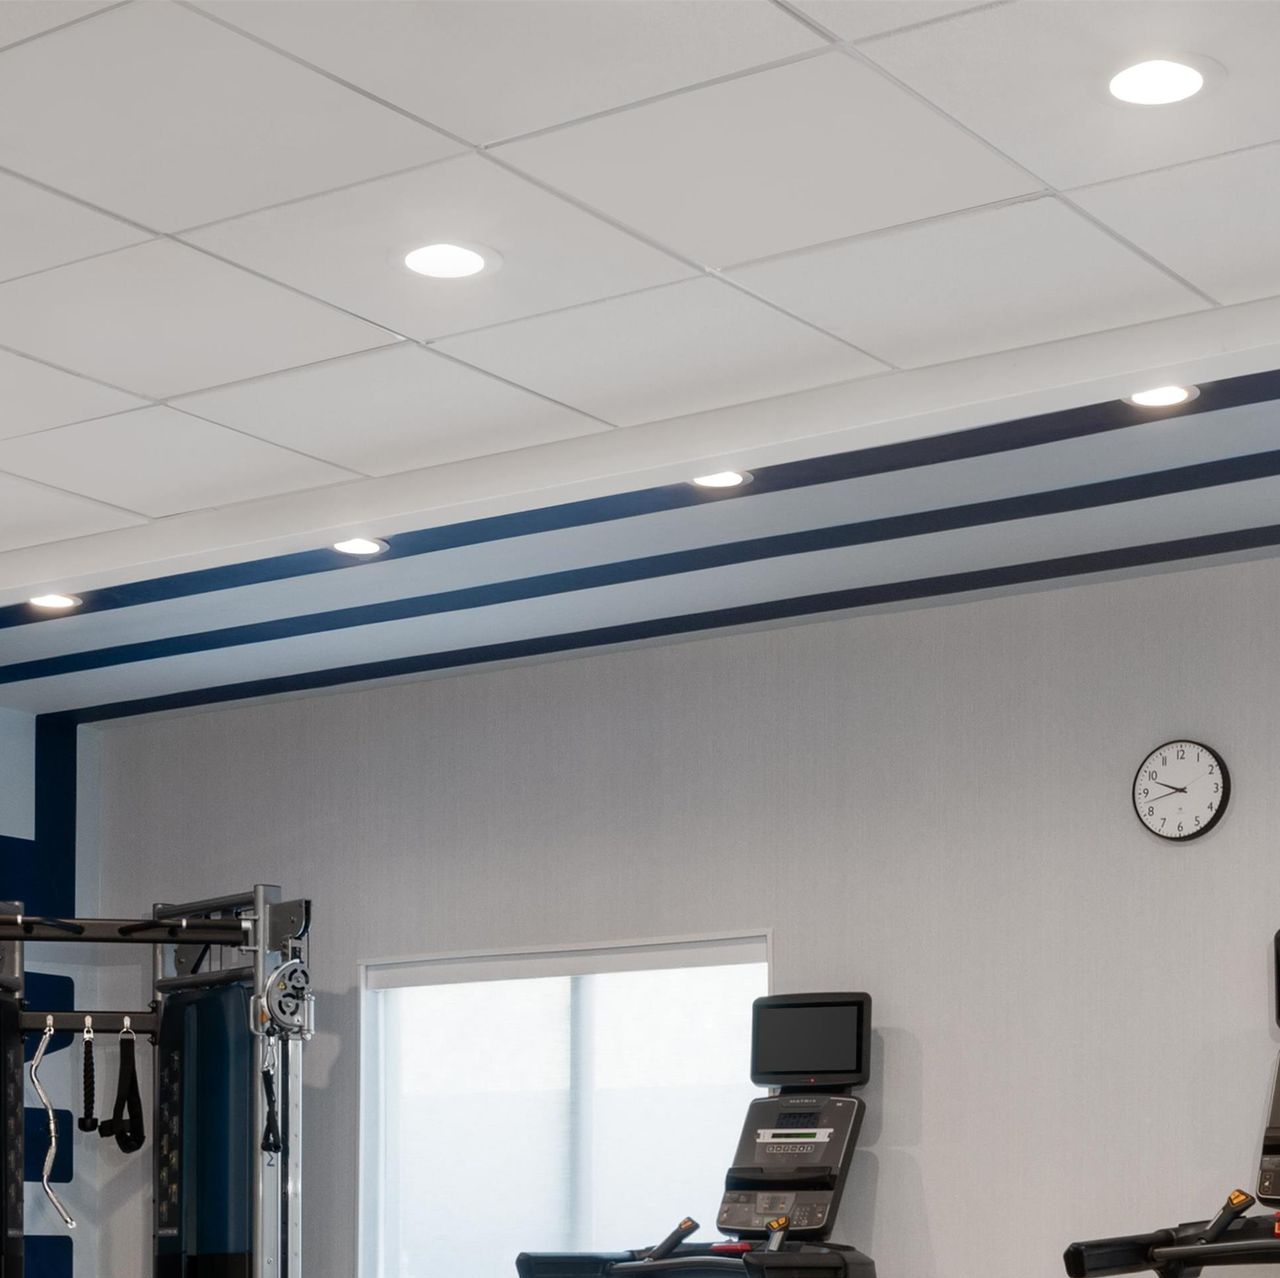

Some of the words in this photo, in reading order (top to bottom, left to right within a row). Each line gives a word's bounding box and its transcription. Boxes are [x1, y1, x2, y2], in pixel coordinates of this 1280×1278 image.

[1176, 749, 1186, 760] 12
[1161, 756, 1167, 766] 11
[1208, 764, 1214, 775] 2
[1148, 770, 1158, 781] 10
[1214, 782, 1219, 793] 3
[1142, 788, 1149, 798] 9
[1148, 806, 1154, 816] 8
[1207, 802, 1214, 812] 4
[1160, 818, 1167, 828] 7
[1194, 816, 1200, 826] 5
[1177, 822, 1183, 832] 6
